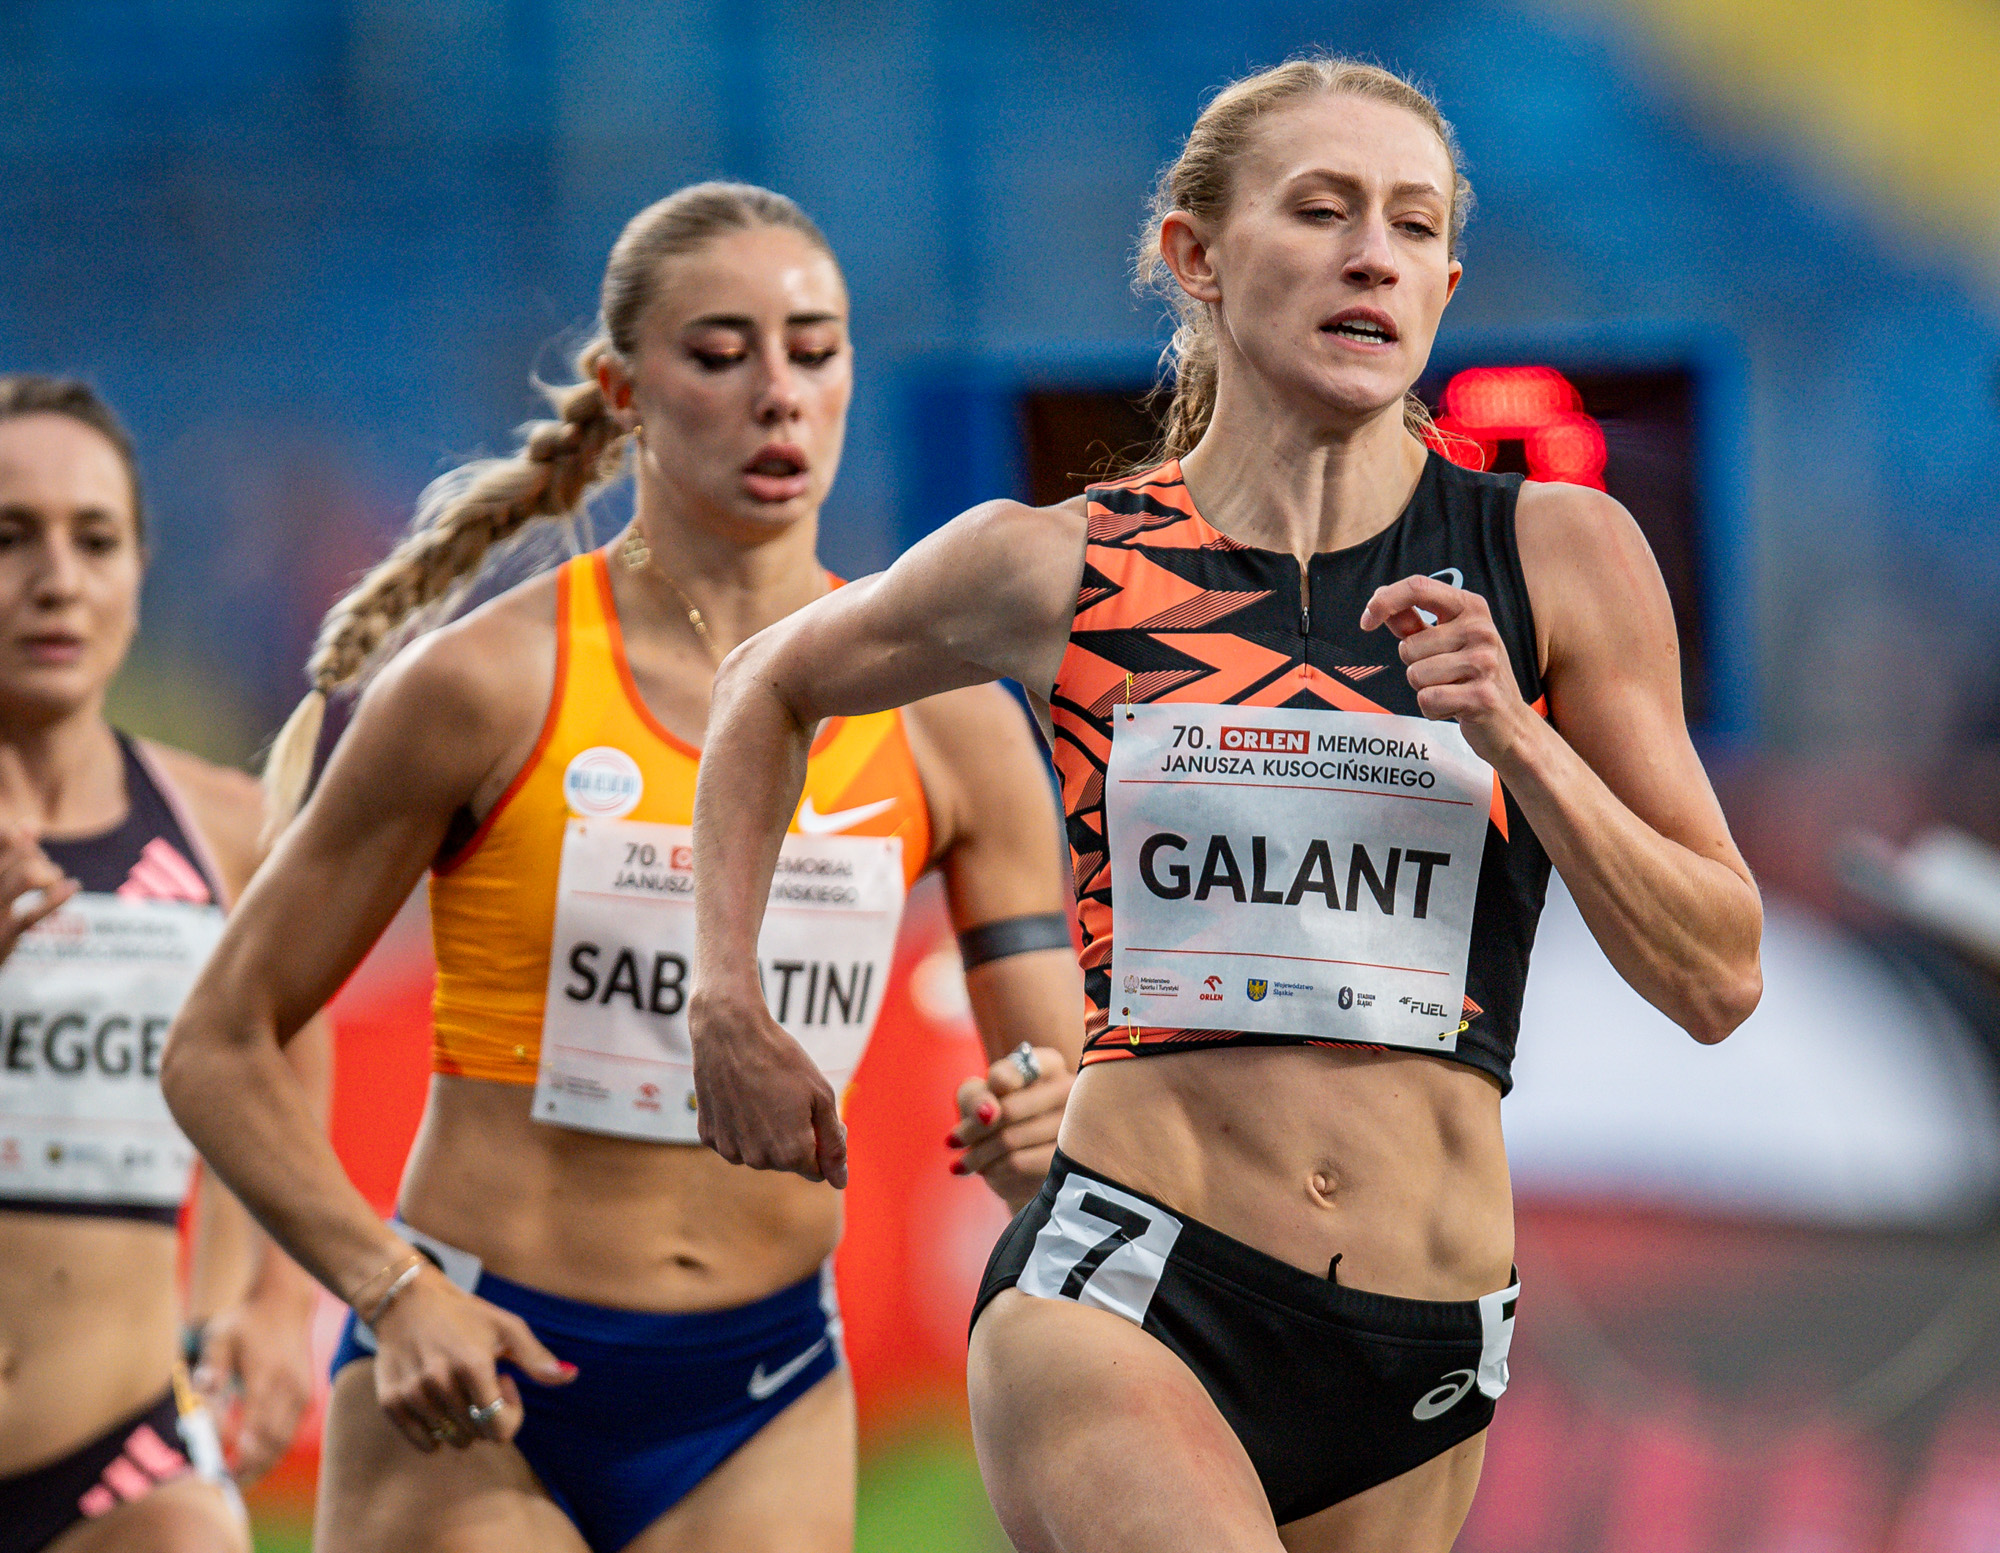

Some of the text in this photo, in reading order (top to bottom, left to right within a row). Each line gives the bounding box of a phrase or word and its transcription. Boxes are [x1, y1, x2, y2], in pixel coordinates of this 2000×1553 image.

[1171, 724, 1429, 761] 70. ORLEN MEMORIAŁ
[1161, 754, 1436, 789] JANUSZA KUSOCIŃSKIEGO
[614, 870, 695, 893] JANUSZ
[1139, 832, 1451, 919] GALANT
[564, 941, 874, 1025] SABTINI
[1140, 976, 1170, 984] Ministerstwo
[1273, 981, 1314, 991] Województwo
[1199, 993, 1223, 1001] ORLEN
[1410, 1001, 1448, 1017] FUEL
[1059, 1191, 1152, 1301] 7
